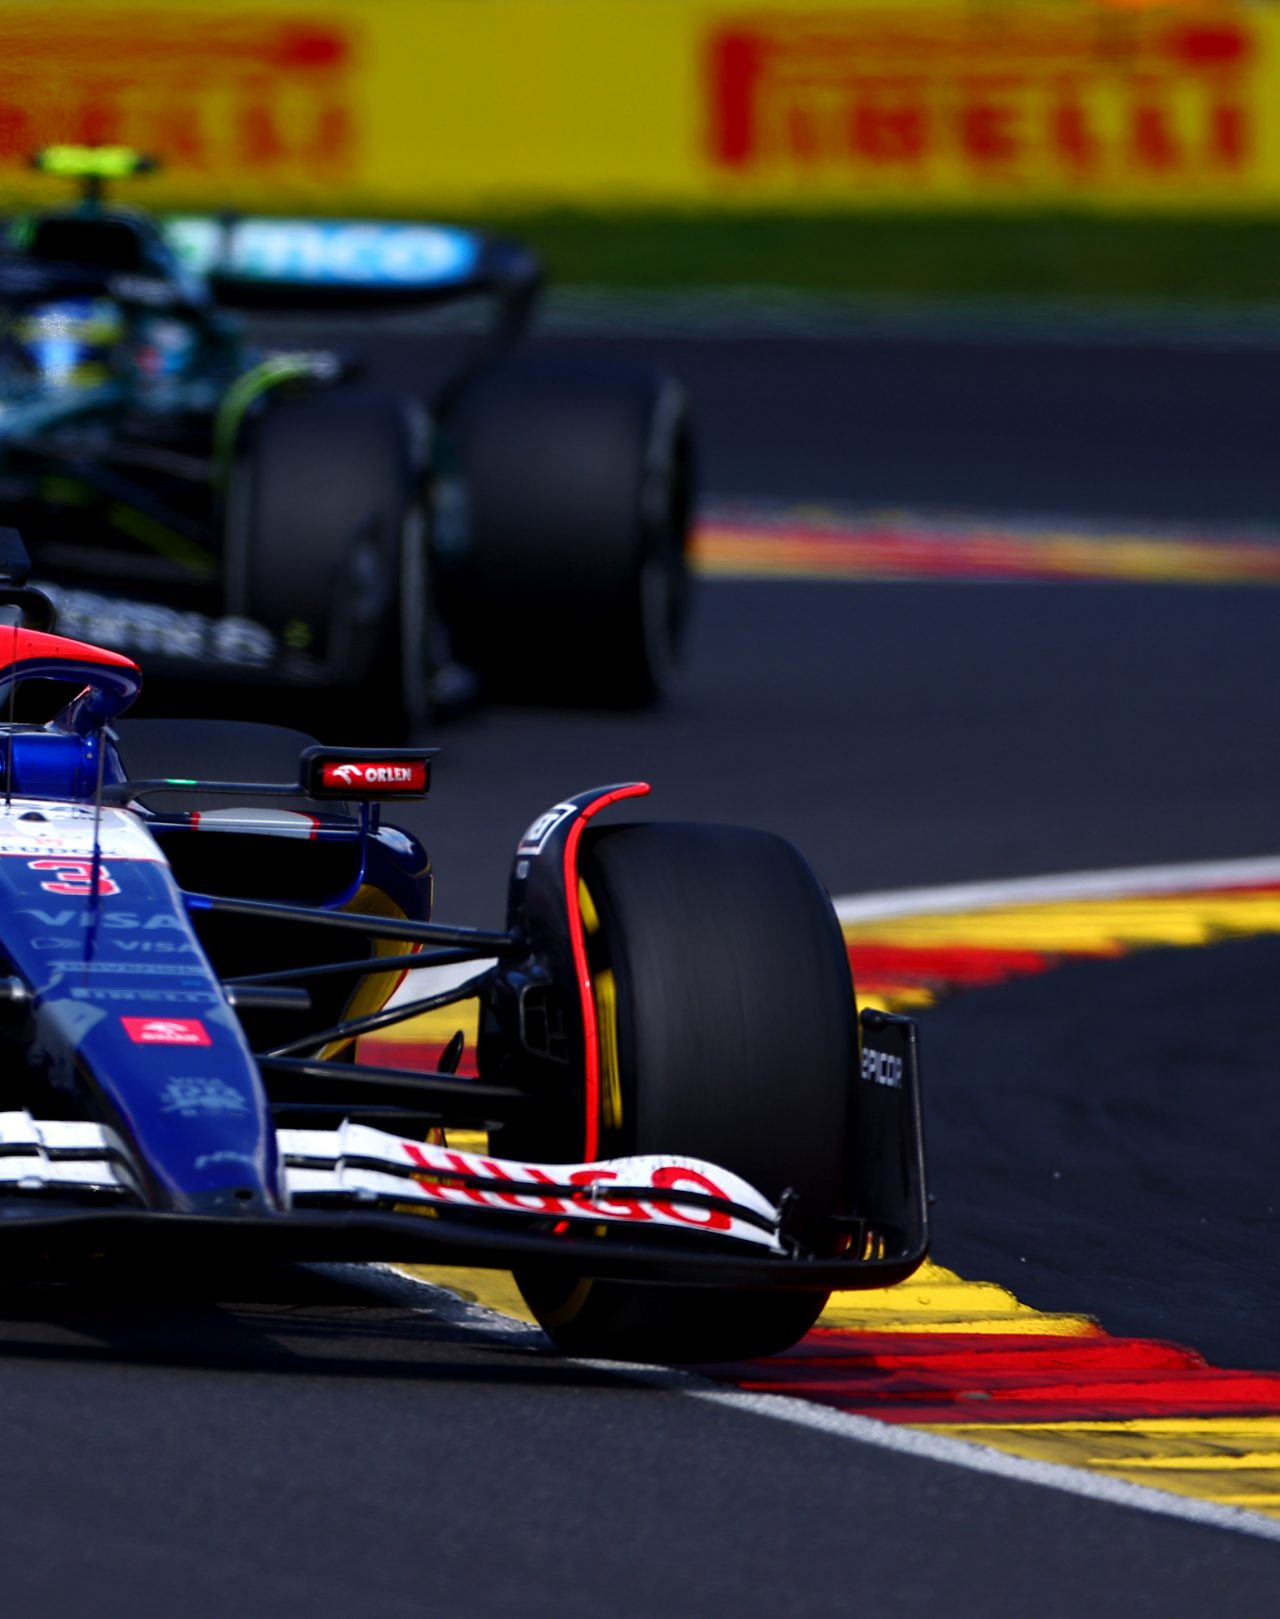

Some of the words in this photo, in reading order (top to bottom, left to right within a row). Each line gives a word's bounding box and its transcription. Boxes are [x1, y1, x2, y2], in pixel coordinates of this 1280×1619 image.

[703, 20, 1250, 172] PIRELLI
[365, 767, 412, 783] ORLEN
[28, 860, 121, 896] 3
[16, 909, 189, 931] VISA
[113, 939, 193, 952] VISA
[401, 1143, 733, 1231] HUGO
